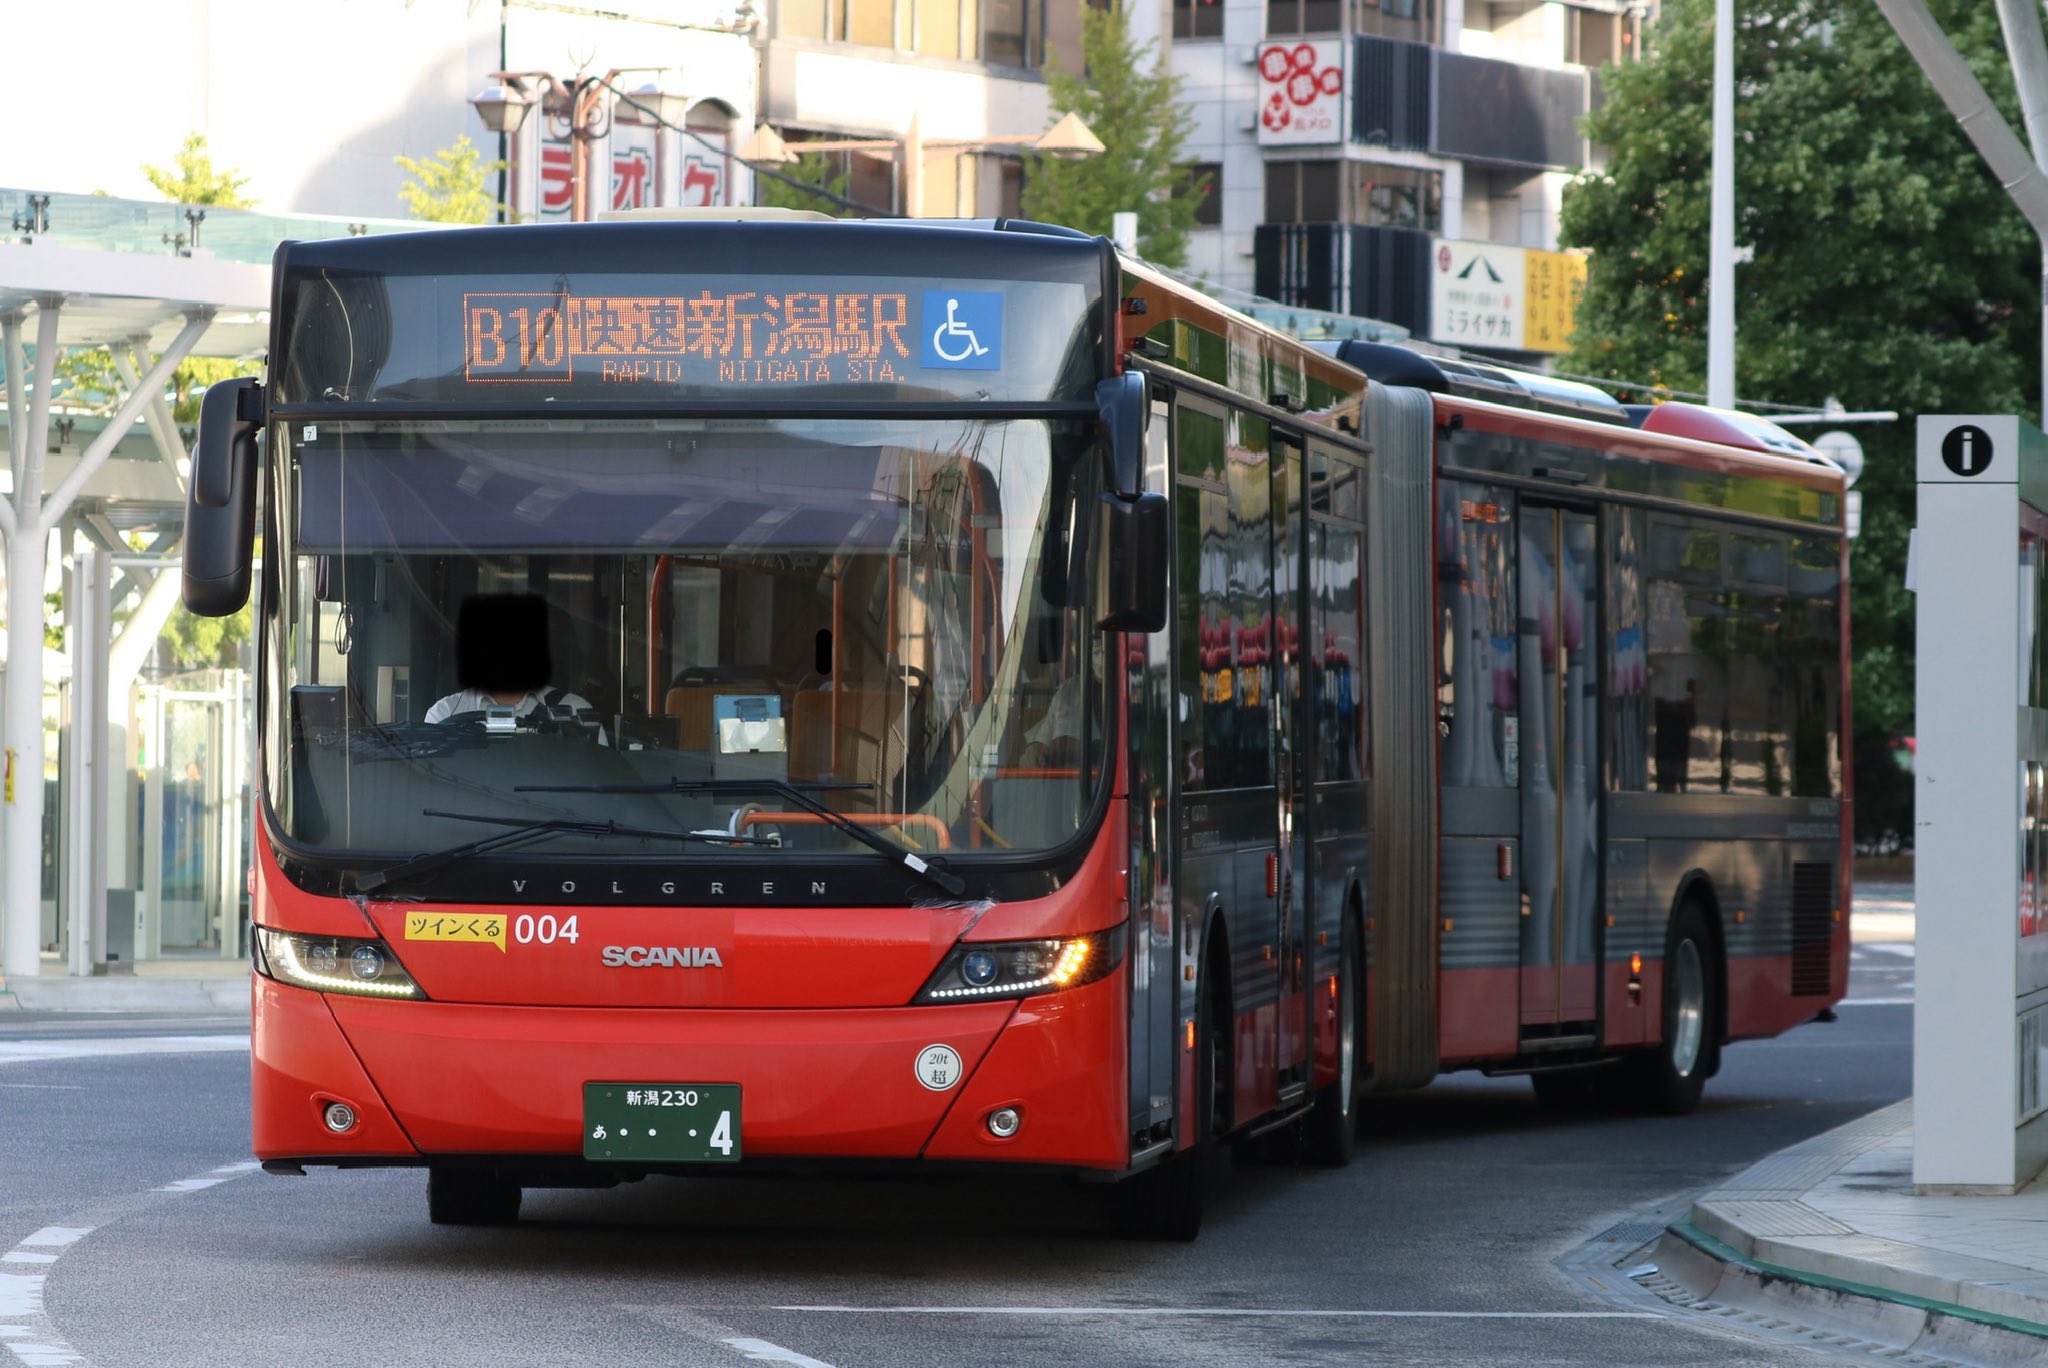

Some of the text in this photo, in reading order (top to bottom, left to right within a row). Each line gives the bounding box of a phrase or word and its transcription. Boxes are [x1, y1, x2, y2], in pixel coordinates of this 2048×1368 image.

[472, 308, 564, 367] B10
[602, 360, 906, 382] RAPID NIIGATA STA.
[513, 879, 826, 895] VOLGREN
[411, 914, 579, 943] ツインくる 004
[602, 945, 723, 968] SCANIA
[929, 1053, 949, 1064] 20t
[931, 1069, 947, 1084] 超
